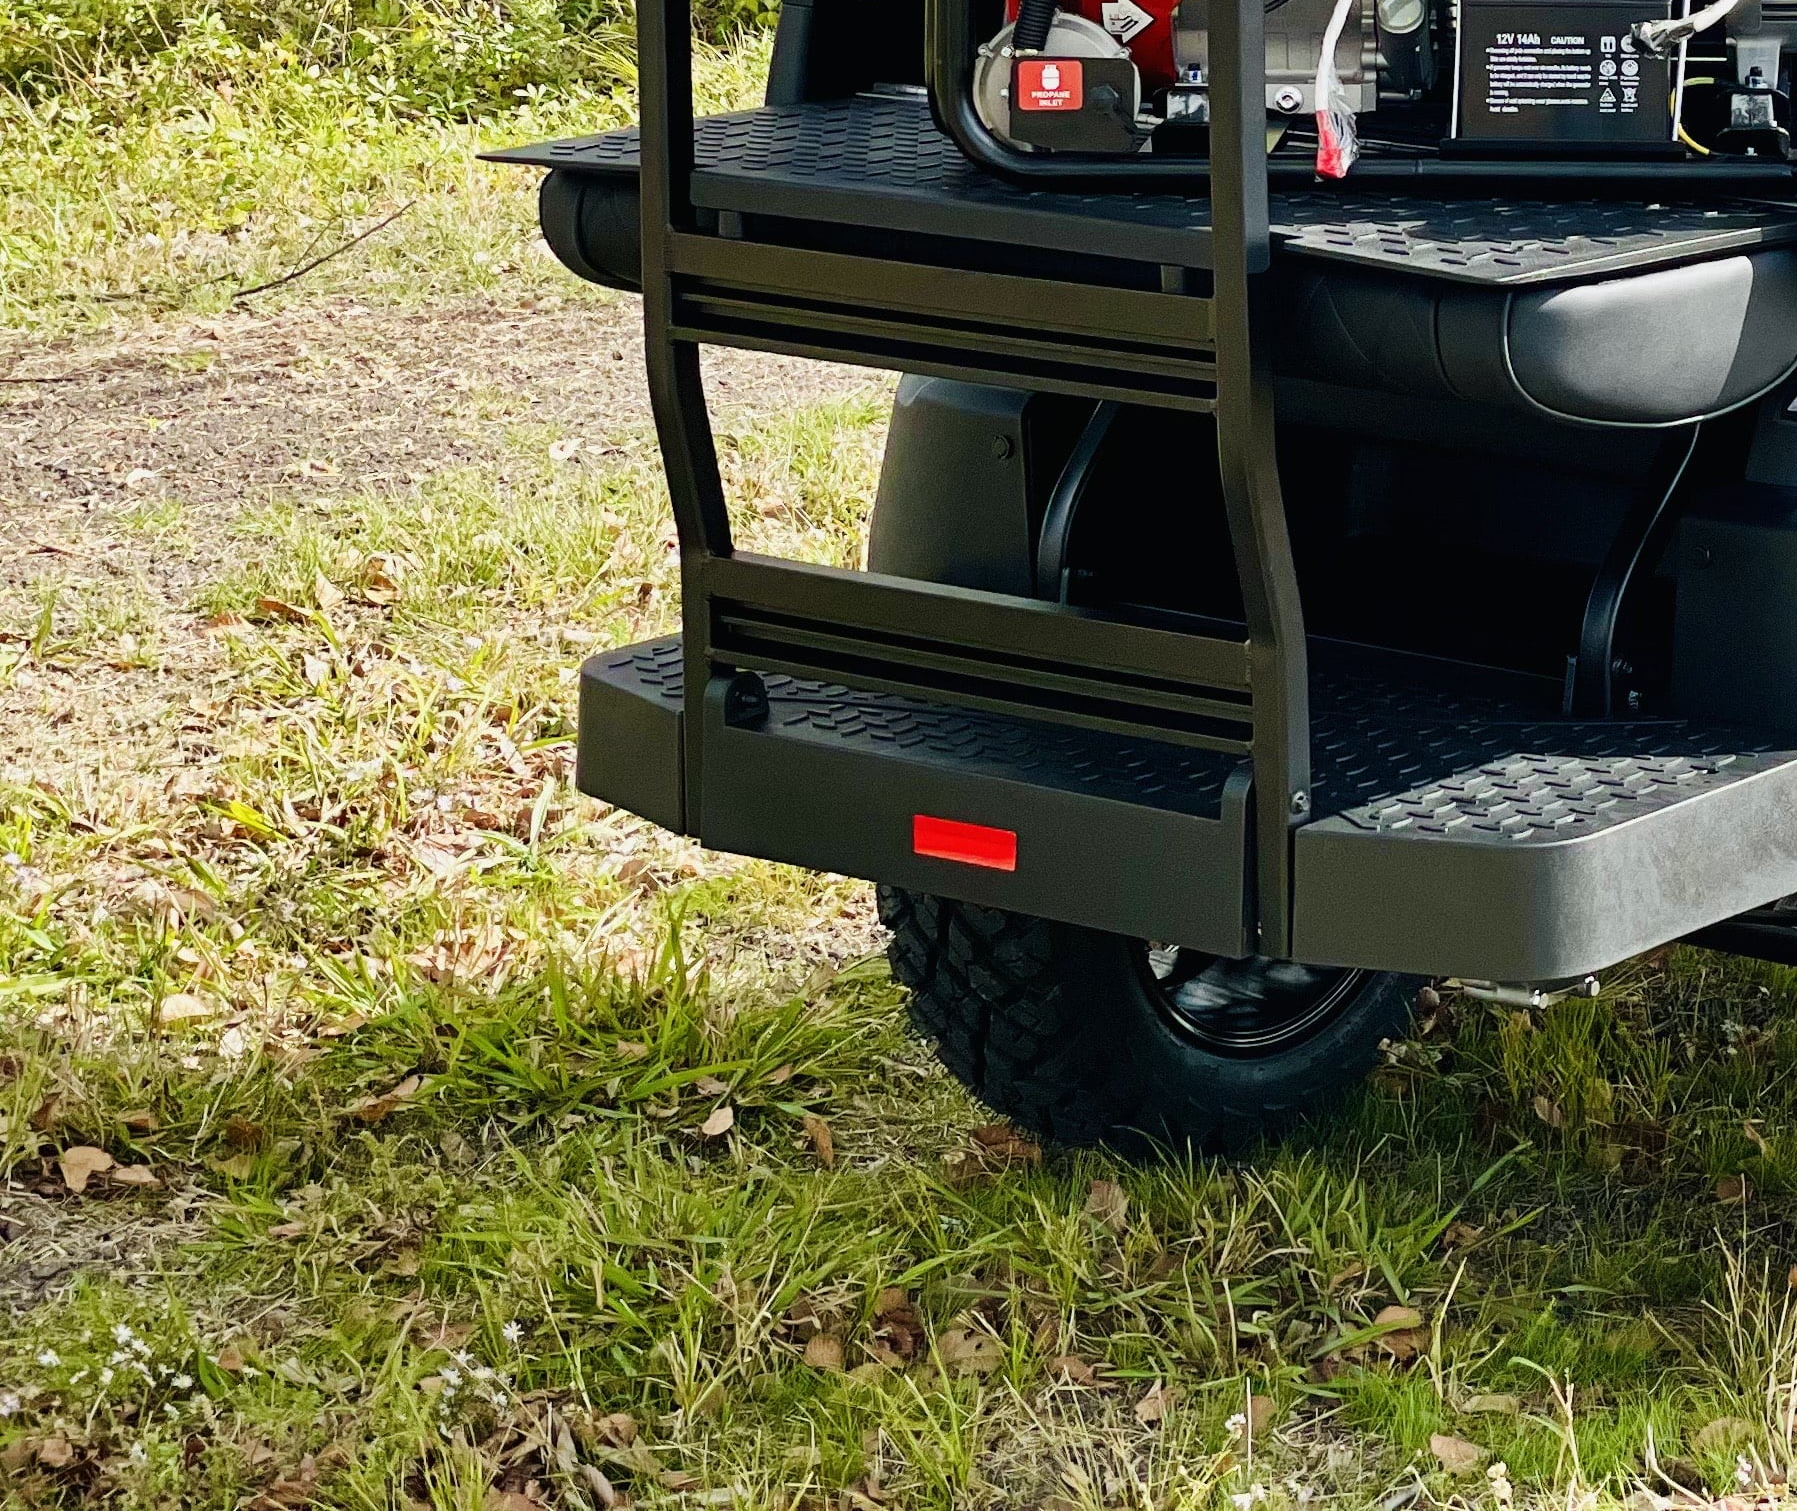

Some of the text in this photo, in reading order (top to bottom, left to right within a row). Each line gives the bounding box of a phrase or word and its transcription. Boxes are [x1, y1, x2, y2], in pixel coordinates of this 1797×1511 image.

[1496, 33, 1585, 45] 12V 14Ah CAUTION
